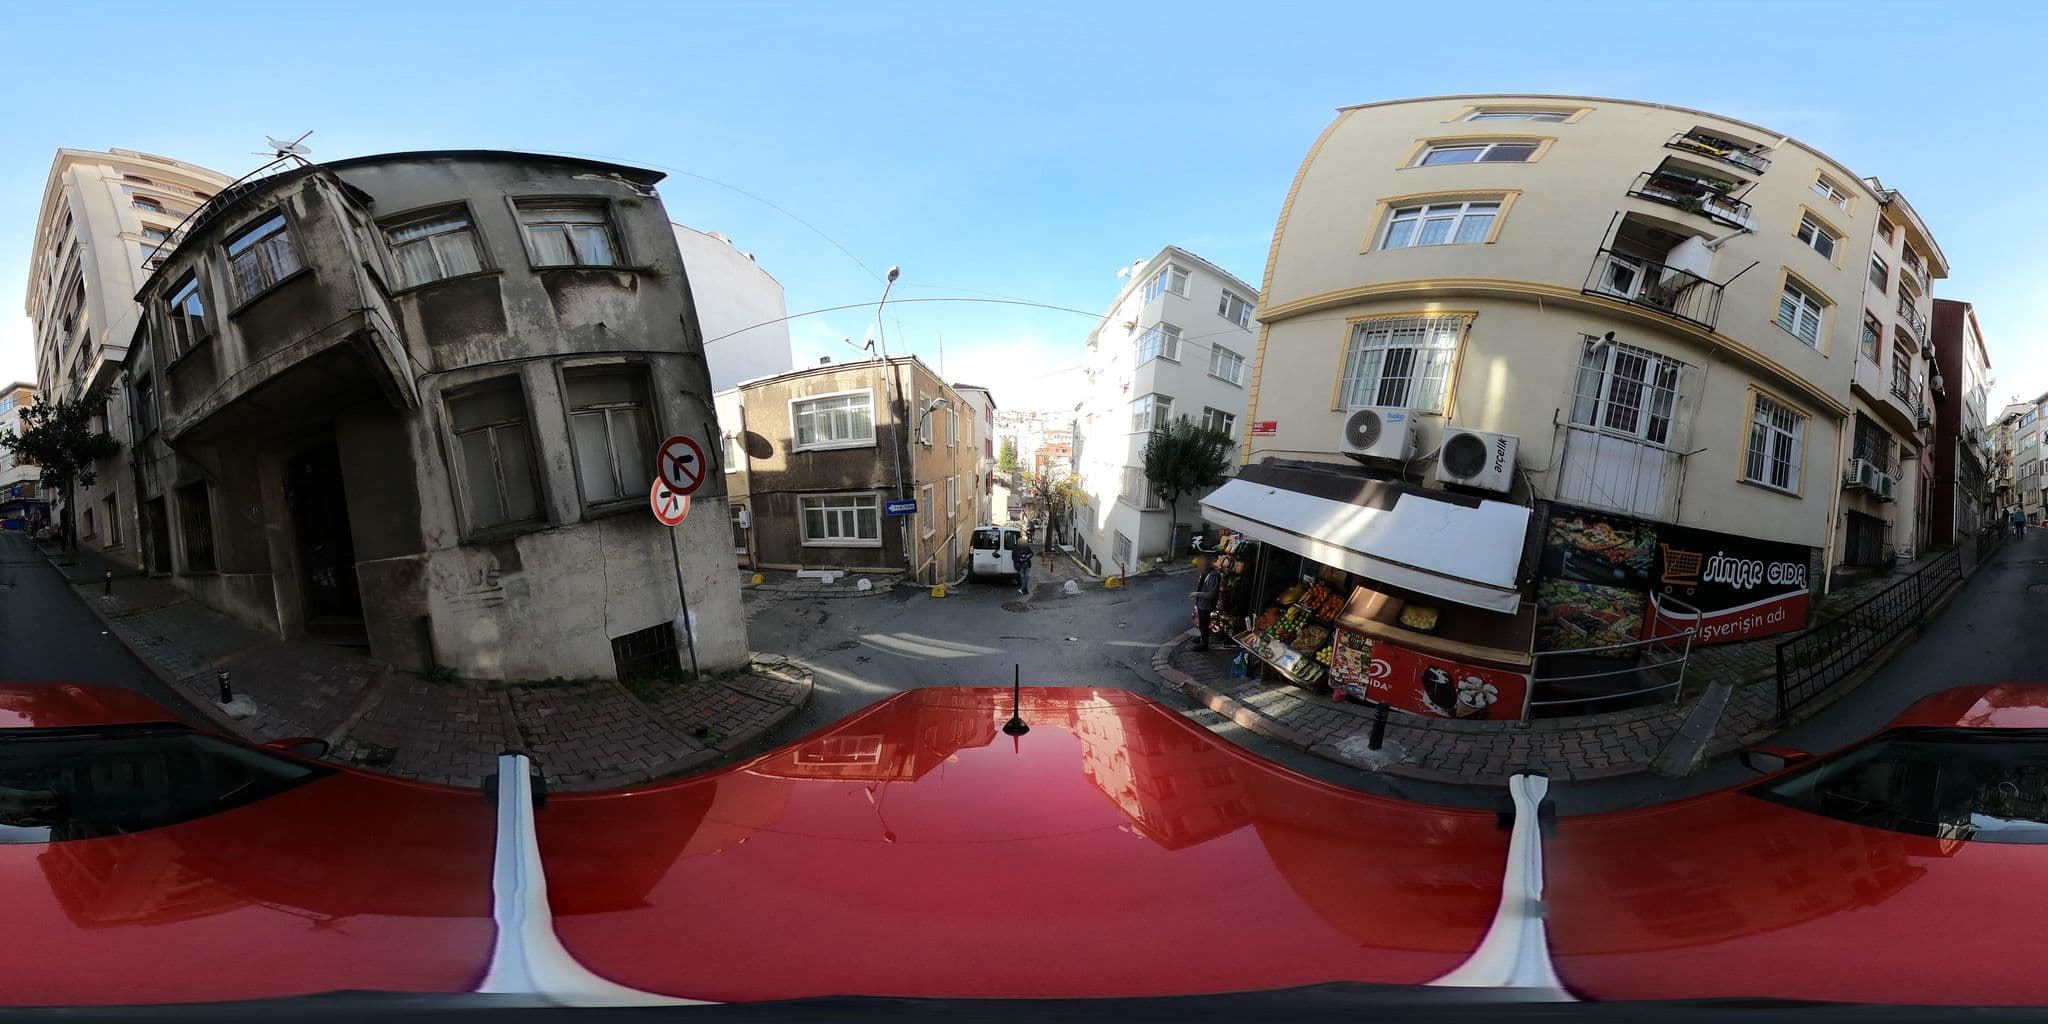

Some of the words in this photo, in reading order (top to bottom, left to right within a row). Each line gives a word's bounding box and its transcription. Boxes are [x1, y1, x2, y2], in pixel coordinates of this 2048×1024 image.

[1387, 412, 1405, 421] beko
[1494, 437, 1508, 473] arçelik
[1767, 562, 1807, 590] GIDA
[1767, 606, 1785, 624] adı
